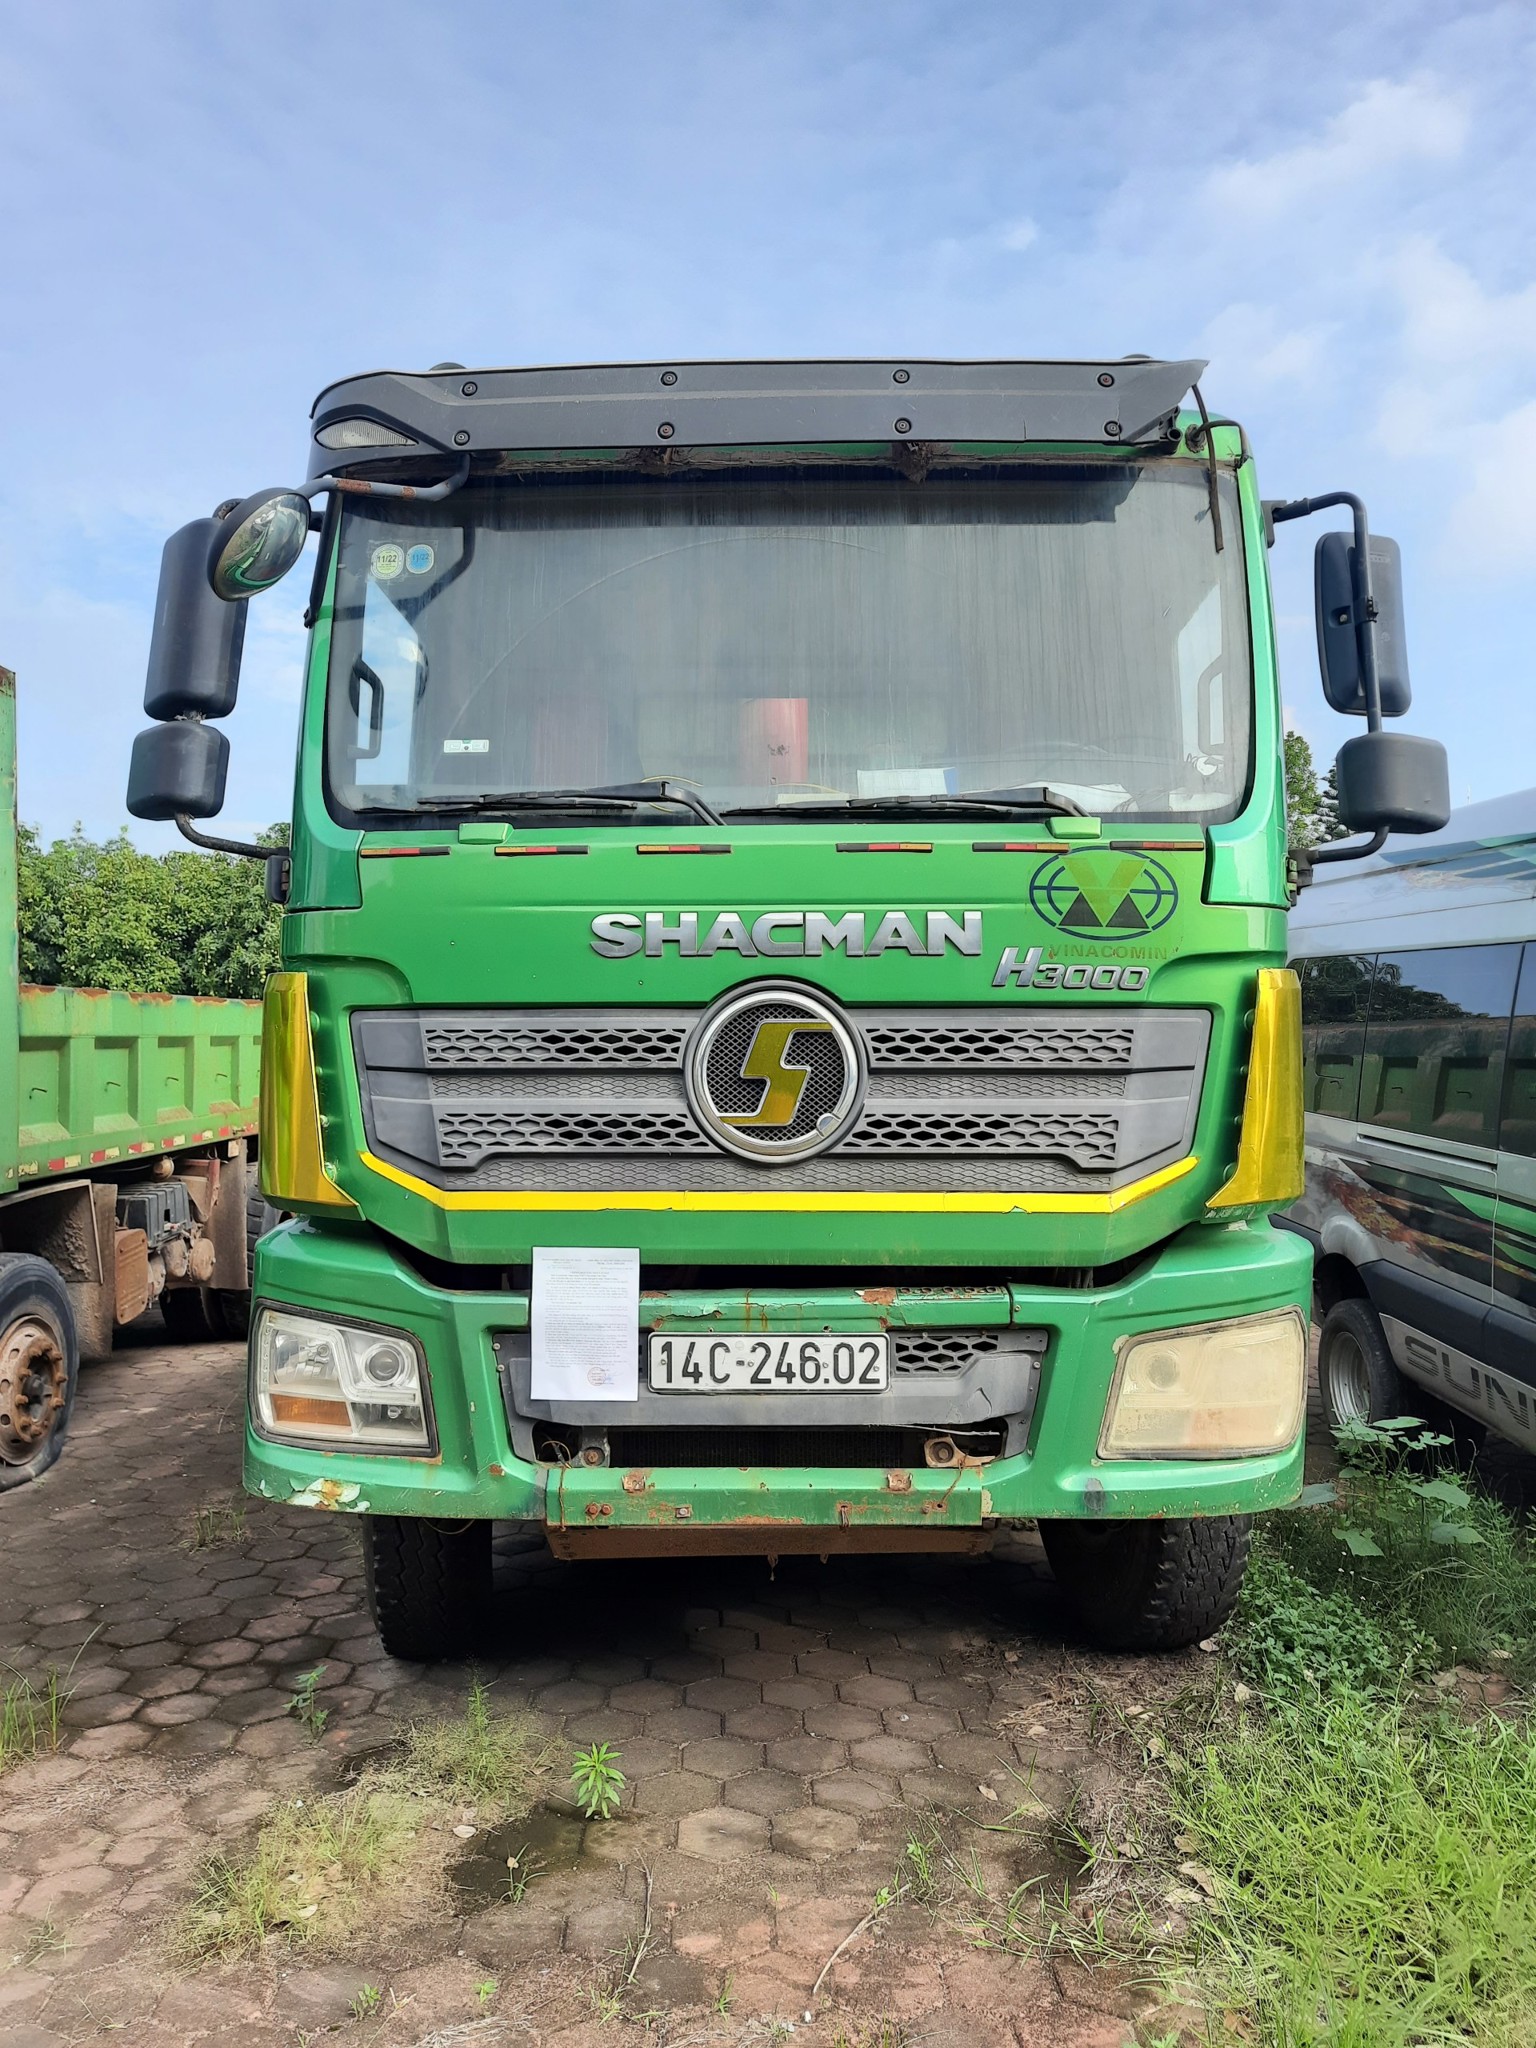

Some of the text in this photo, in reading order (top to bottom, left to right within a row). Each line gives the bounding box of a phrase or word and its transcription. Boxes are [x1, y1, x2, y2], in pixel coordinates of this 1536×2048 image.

[590, 911, 982, 957] SHACMAN
[1049, 944, 1167, 960] VINACOMIN
[991, 946, 1150, 991] H3000
[661, 1341, 880, 1384] 14C-246.02
[1405, 1335, 1536, 1430] SUN
